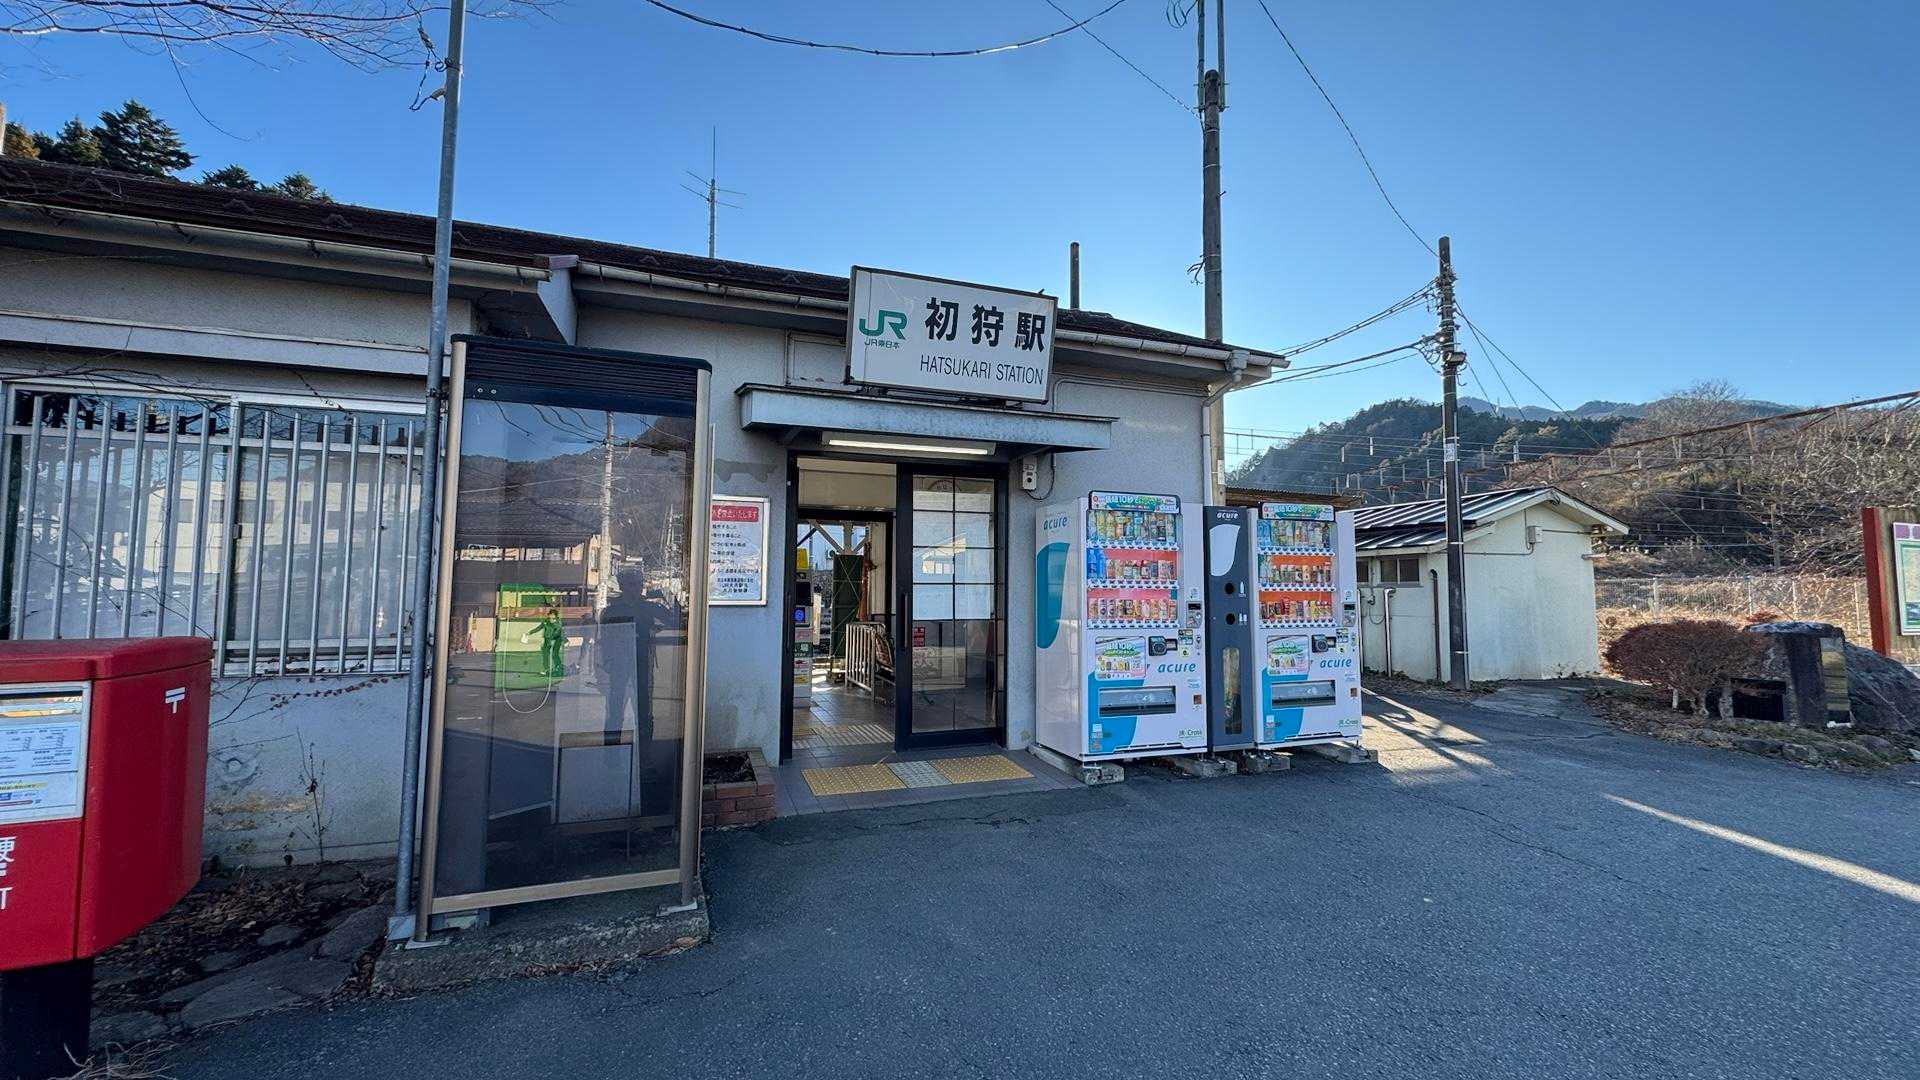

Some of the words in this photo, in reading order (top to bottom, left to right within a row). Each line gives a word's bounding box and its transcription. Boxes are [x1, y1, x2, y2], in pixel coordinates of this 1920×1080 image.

[859, 310, 908, 340] JR
[925, 297, 1046, 352] 初狩駅
[920, 355, 991, 380] HATSUKARI
[996, 363, 1044, 384] STATION
[1043, 515, 1068, 531] acure
[1158, 662, 1196, 673] acure
[1320, 657, 1352, 668] acure
